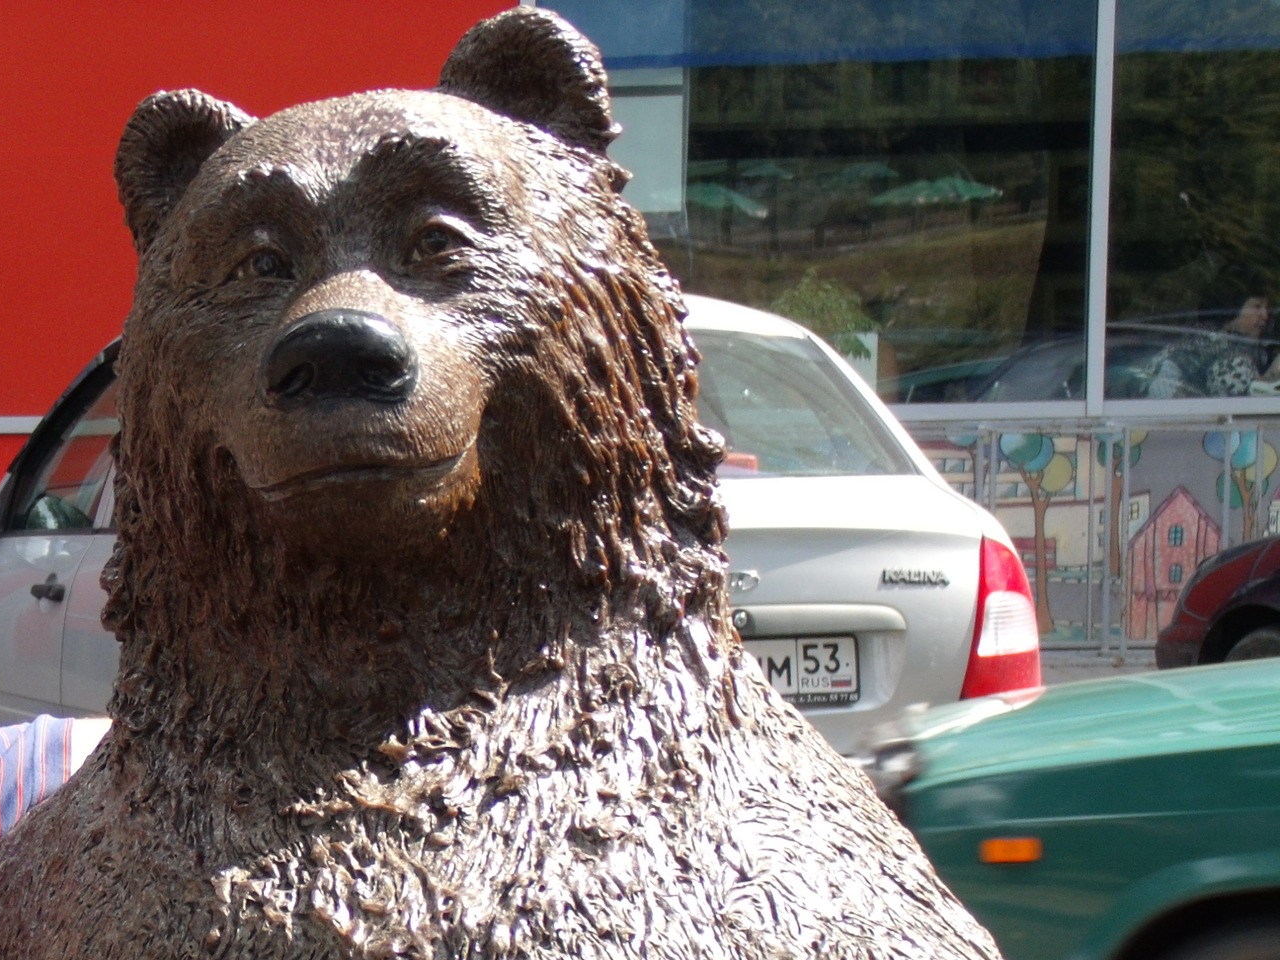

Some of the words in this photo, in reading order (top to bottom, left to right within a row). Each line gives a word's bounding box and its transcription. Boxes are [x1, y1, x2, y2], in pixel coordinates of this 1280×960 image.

[882, 569, 950, 586] KALINA
[757, 656, 792, 687] M
[802, 643, 840, 674] 53
[801, 677, 830, 688] RUS
